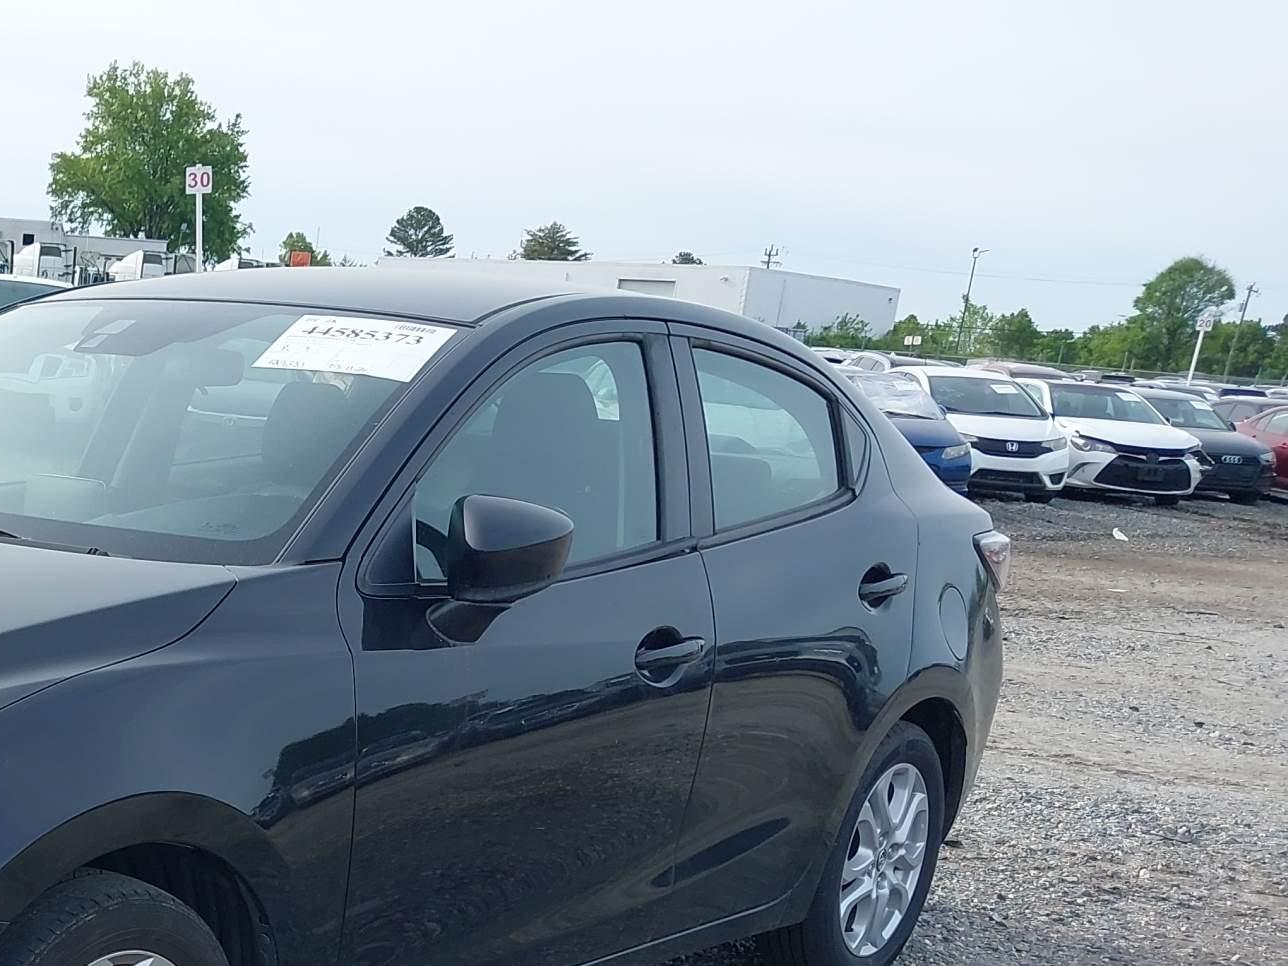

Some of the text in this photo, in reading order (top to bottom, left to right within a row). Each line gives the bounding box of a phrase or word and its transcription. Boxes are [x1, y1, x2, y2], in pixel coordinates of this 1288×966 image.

[187, 171, 211, 189] 30
[1198, 319, 1212, 328] 20
[302, 325, 424, 345] 44585373
